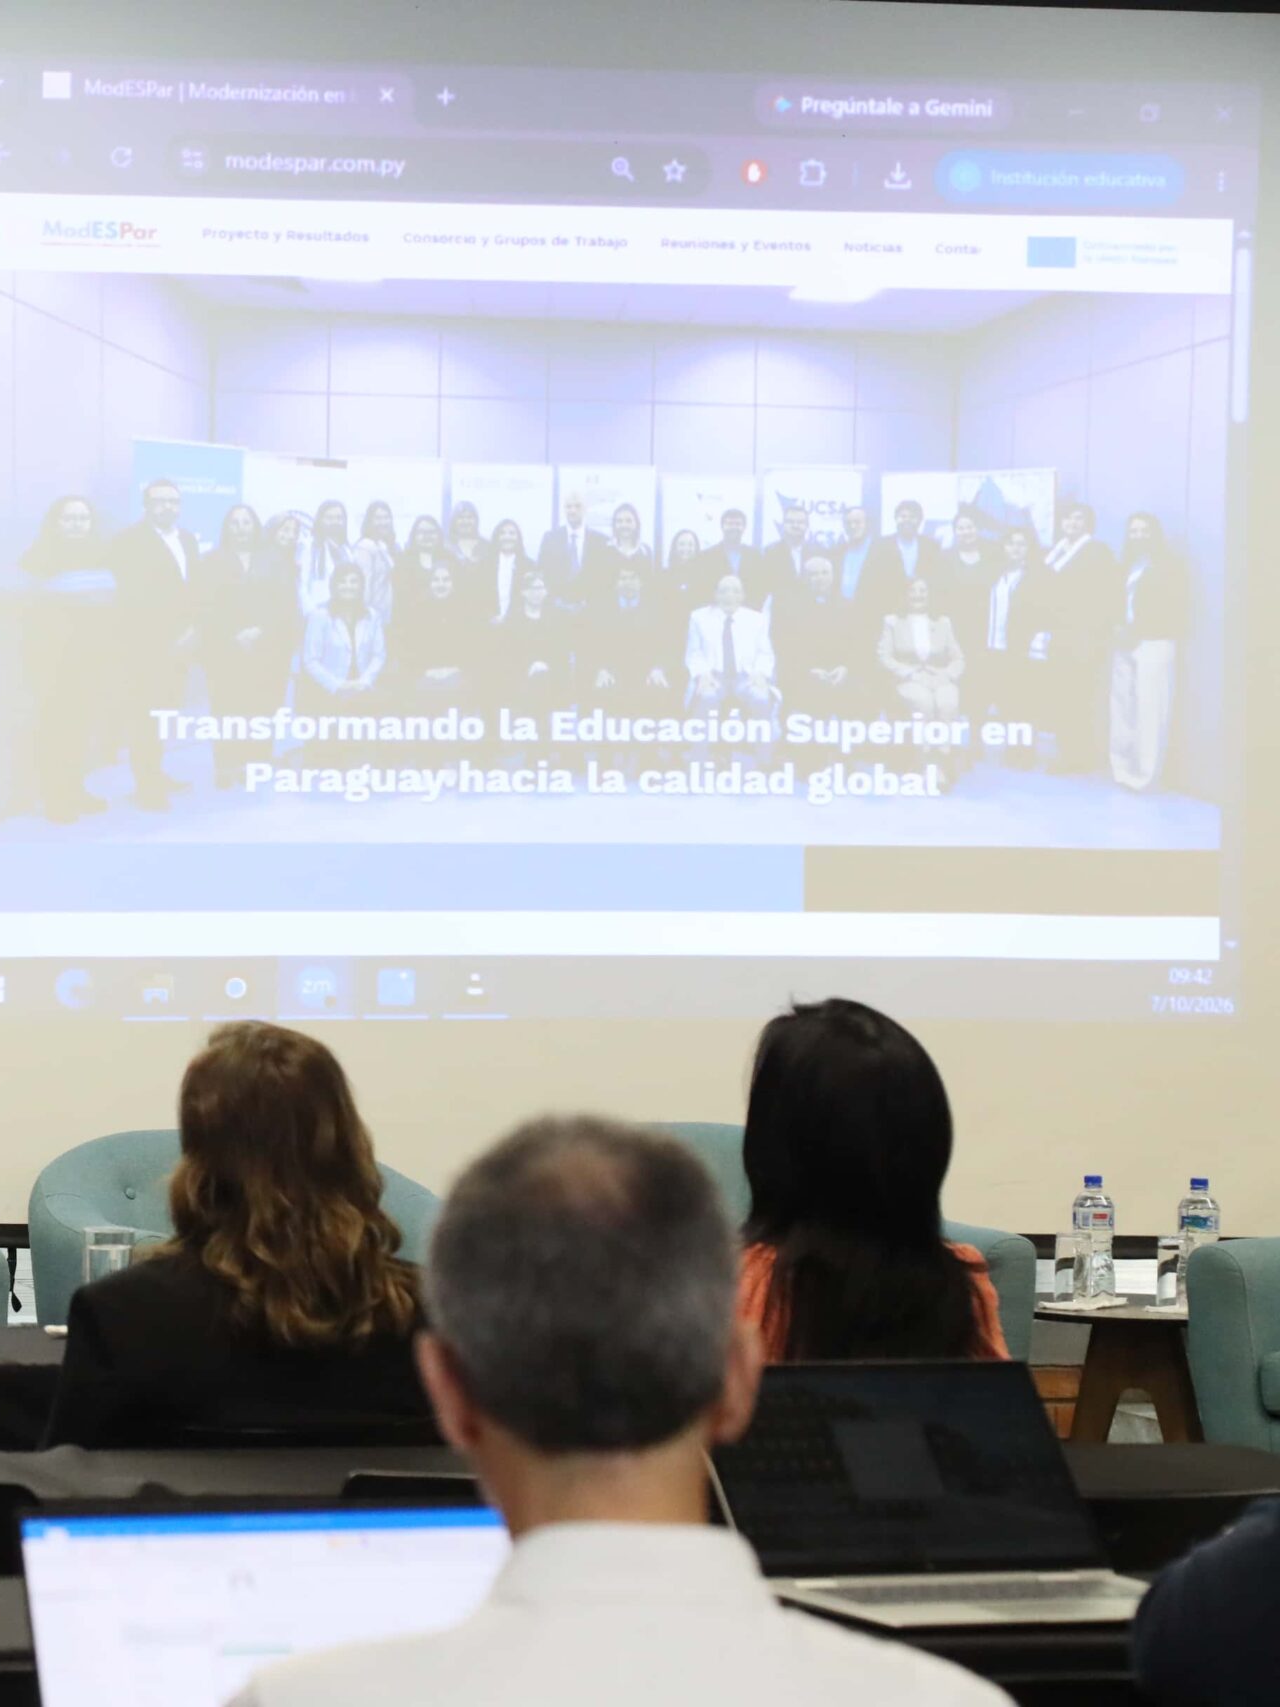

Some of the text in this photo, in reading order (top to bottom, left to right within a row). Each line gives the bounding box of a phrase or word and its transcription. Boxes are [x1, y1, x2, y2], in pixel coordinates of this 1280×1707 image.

[84, 77, 174, 99] ModESPar
[189, 80, 319, 105] Modernización
[323, 88, 346, 103] en
[801, 95, 993, 118] Pregúntale a Gemini
[224, 151, 406, 179] modespar.com.py
[1084, 169, 1167, 189] educativa
[41, 220, 159, 242] ModESPar
[202, 227, 370, 244] Proyecto y Resultados
[402, 231, 629, 252] Consorcio y Grupos de Trabajo
[660, 236, 812, 253] Reuniones y Eventos
[844, 240, 904, 255] Noticias
[150, 706, 1033, 754] Transformando la Educación Superior en
[246, 760, 941, 805] Paraguay hacia la calidad global
